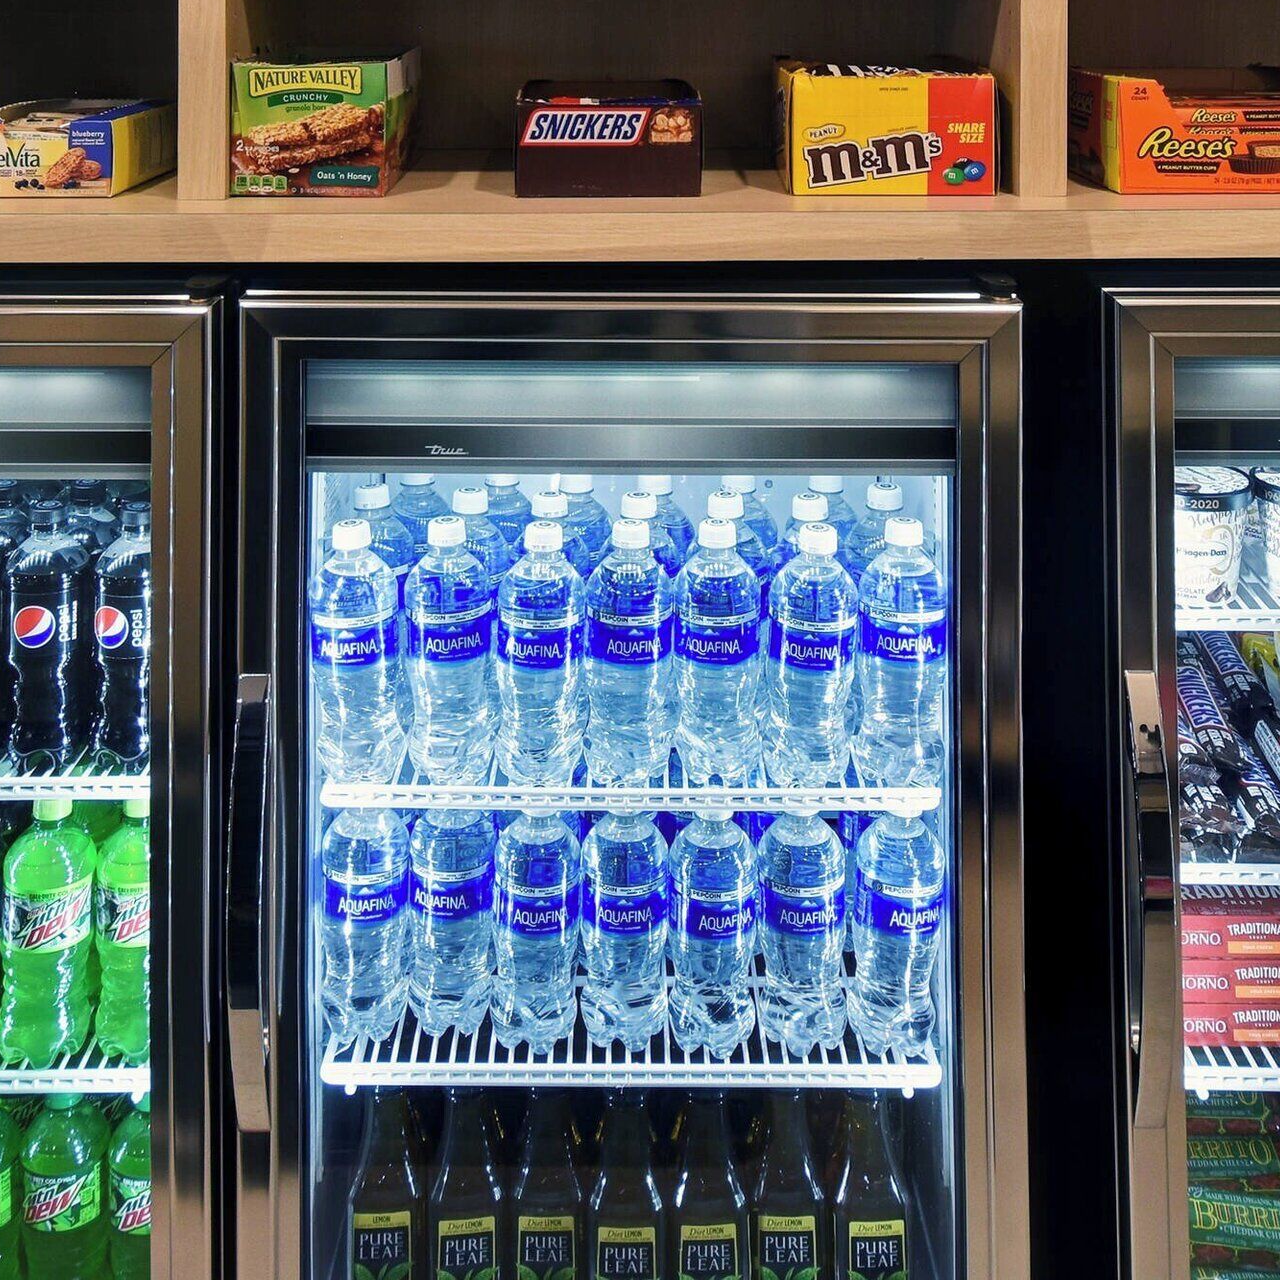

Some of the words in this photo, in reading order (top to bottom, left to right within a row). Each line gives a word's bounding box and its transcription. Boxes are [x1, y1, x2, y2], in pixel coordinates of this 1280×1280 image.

[254, 69, 307, 92] NATURE
[308, 69, 358, 90] VALLEY
[282, 94, 329, 102] CRUNCHY
[1133, 87, 1148, 96] 24
[285, 104, 311, 113] granola
[1191, 108, 1237, 124] Reese's
[71, 130, 105, 138] blueberry
[529, 114, 641, 142] SNICKERS
[809, 126, 838, 138] PEANUT
[947, 122, 986, 134] SHARE
[959, 133, 985, 144] SIZE
[1138, 125, 1237, 159] Reese's
[317, 171, 336, 180] Oats
[346, 172, 372, 183] Honey
[321, 637, 380, 658] AQUAFINA
[426, 632, 484, 656] AQUAFINA
[1221, 898, 1265, 906] CRUST
[372, 1214, 391, 1224] LEMON
[360, 1231, 404, 1246] PURE
[446, 1237, 488, 1253] PURE
[525, 1235, 568, 1249] PURE
[359, 1245, 403, 1259] LEAF
[525, 1248, 567, 1262] LEAF
[605, 1247, 649, 1260] PURE
[687, 1244, 731, 1258] PURE
[445, 1251, 488, 1266] LEAF
[604, 1259, 648, 1273] LEAF
